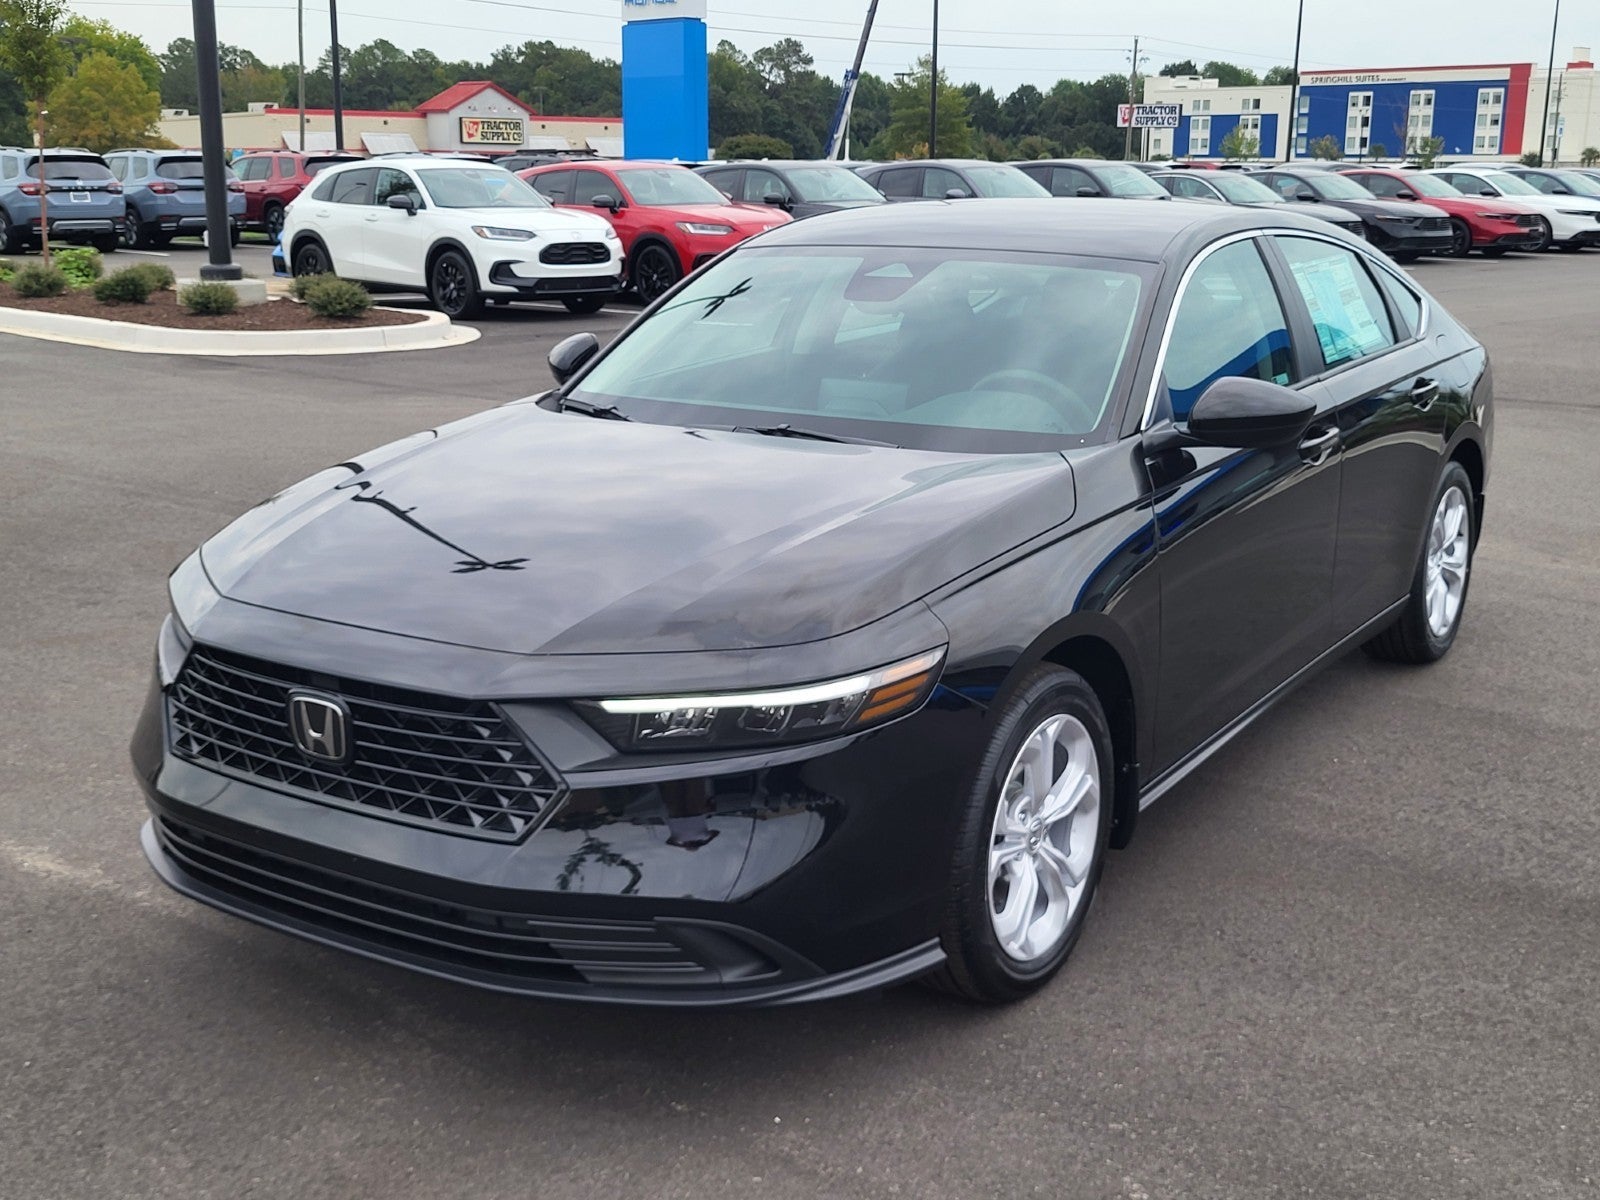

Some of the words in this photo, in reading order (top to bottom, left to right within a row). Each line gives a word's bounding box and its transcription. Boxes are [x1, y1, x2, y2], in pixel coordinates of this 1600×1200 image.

[1311, 75, 1353, 84] SPRINGHILL
[1355, 74, 1380, 82] SUITES
[1136, 106, 1177, 115] TRACTOR
[480, 120, 521, 131] TRACTOR
[1134, 116, 1166, 125] SUPPLY
[480, 131, 511, 141] SUPPLY
